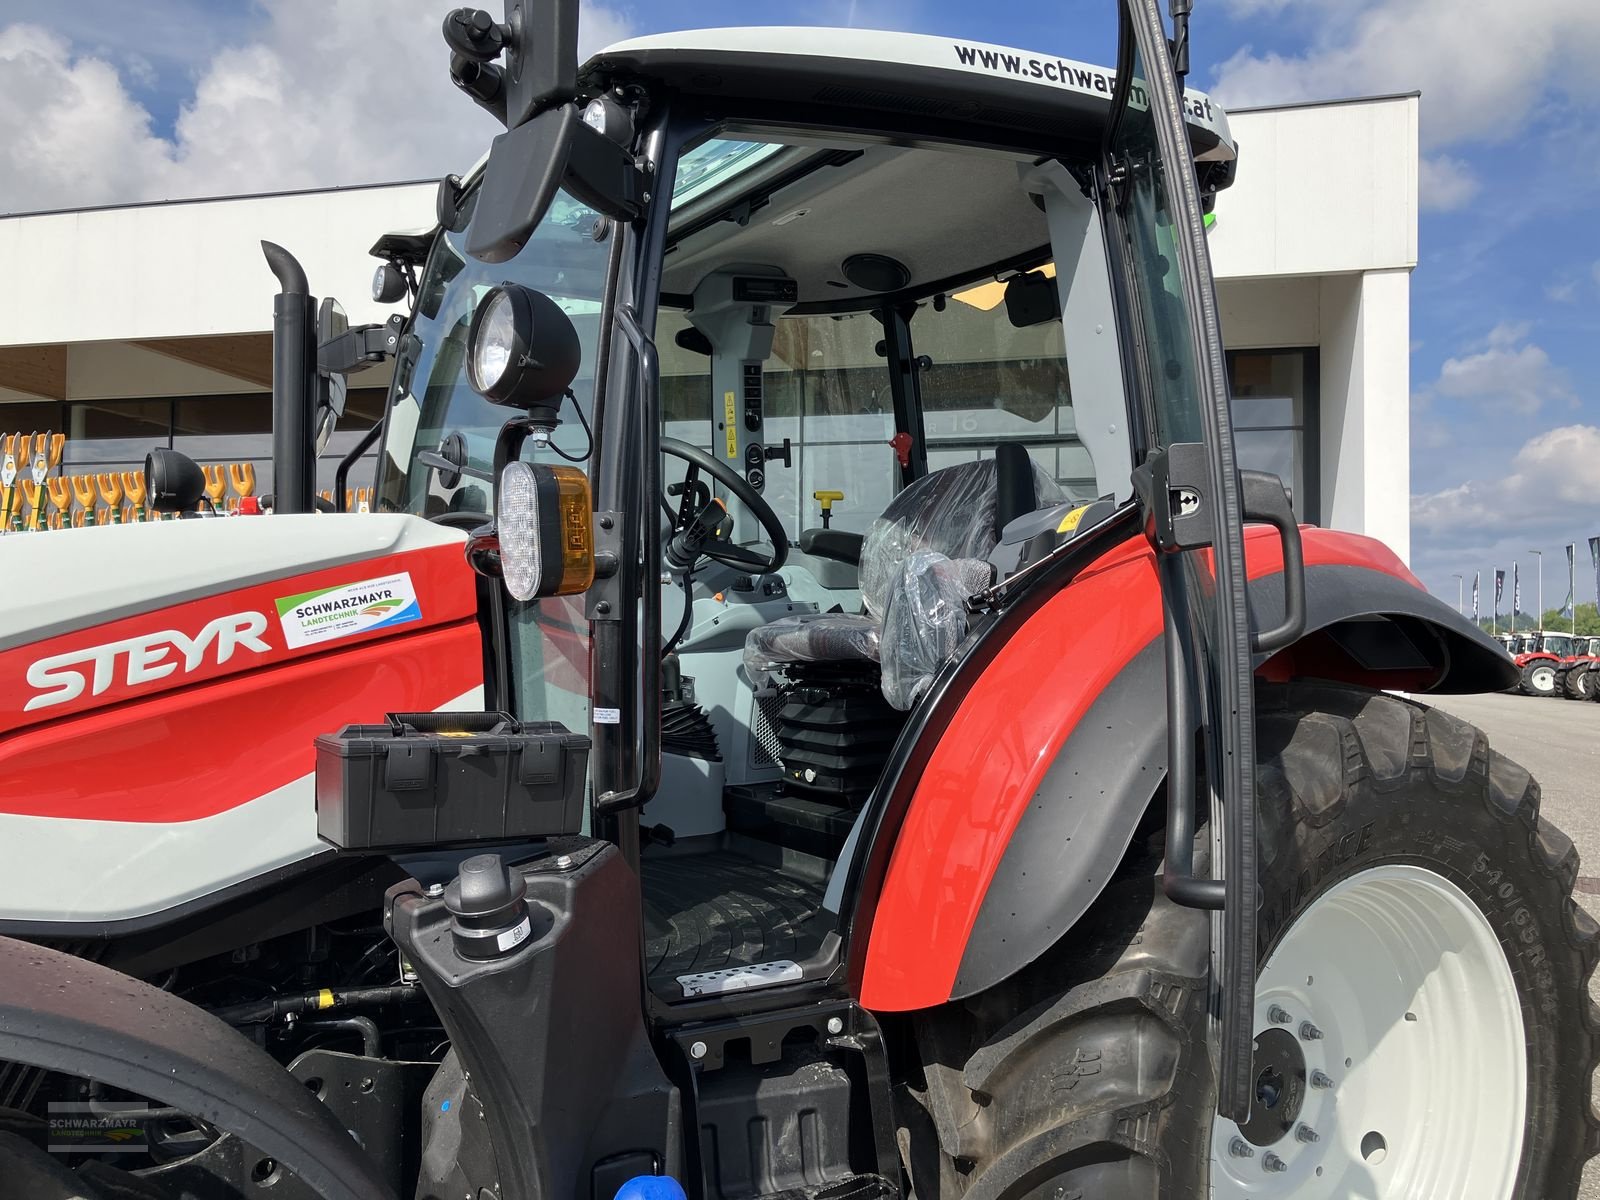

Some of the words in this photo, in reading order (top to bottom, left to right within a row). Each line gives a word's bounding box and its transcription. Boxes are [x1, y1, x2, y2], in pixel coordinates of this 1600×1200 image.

[296, 589, 393, 619] SCHWARZMAYR
[301, 608, 359, 628] LANDTECHNIK
[23, 611, 273, 712] STEYR
